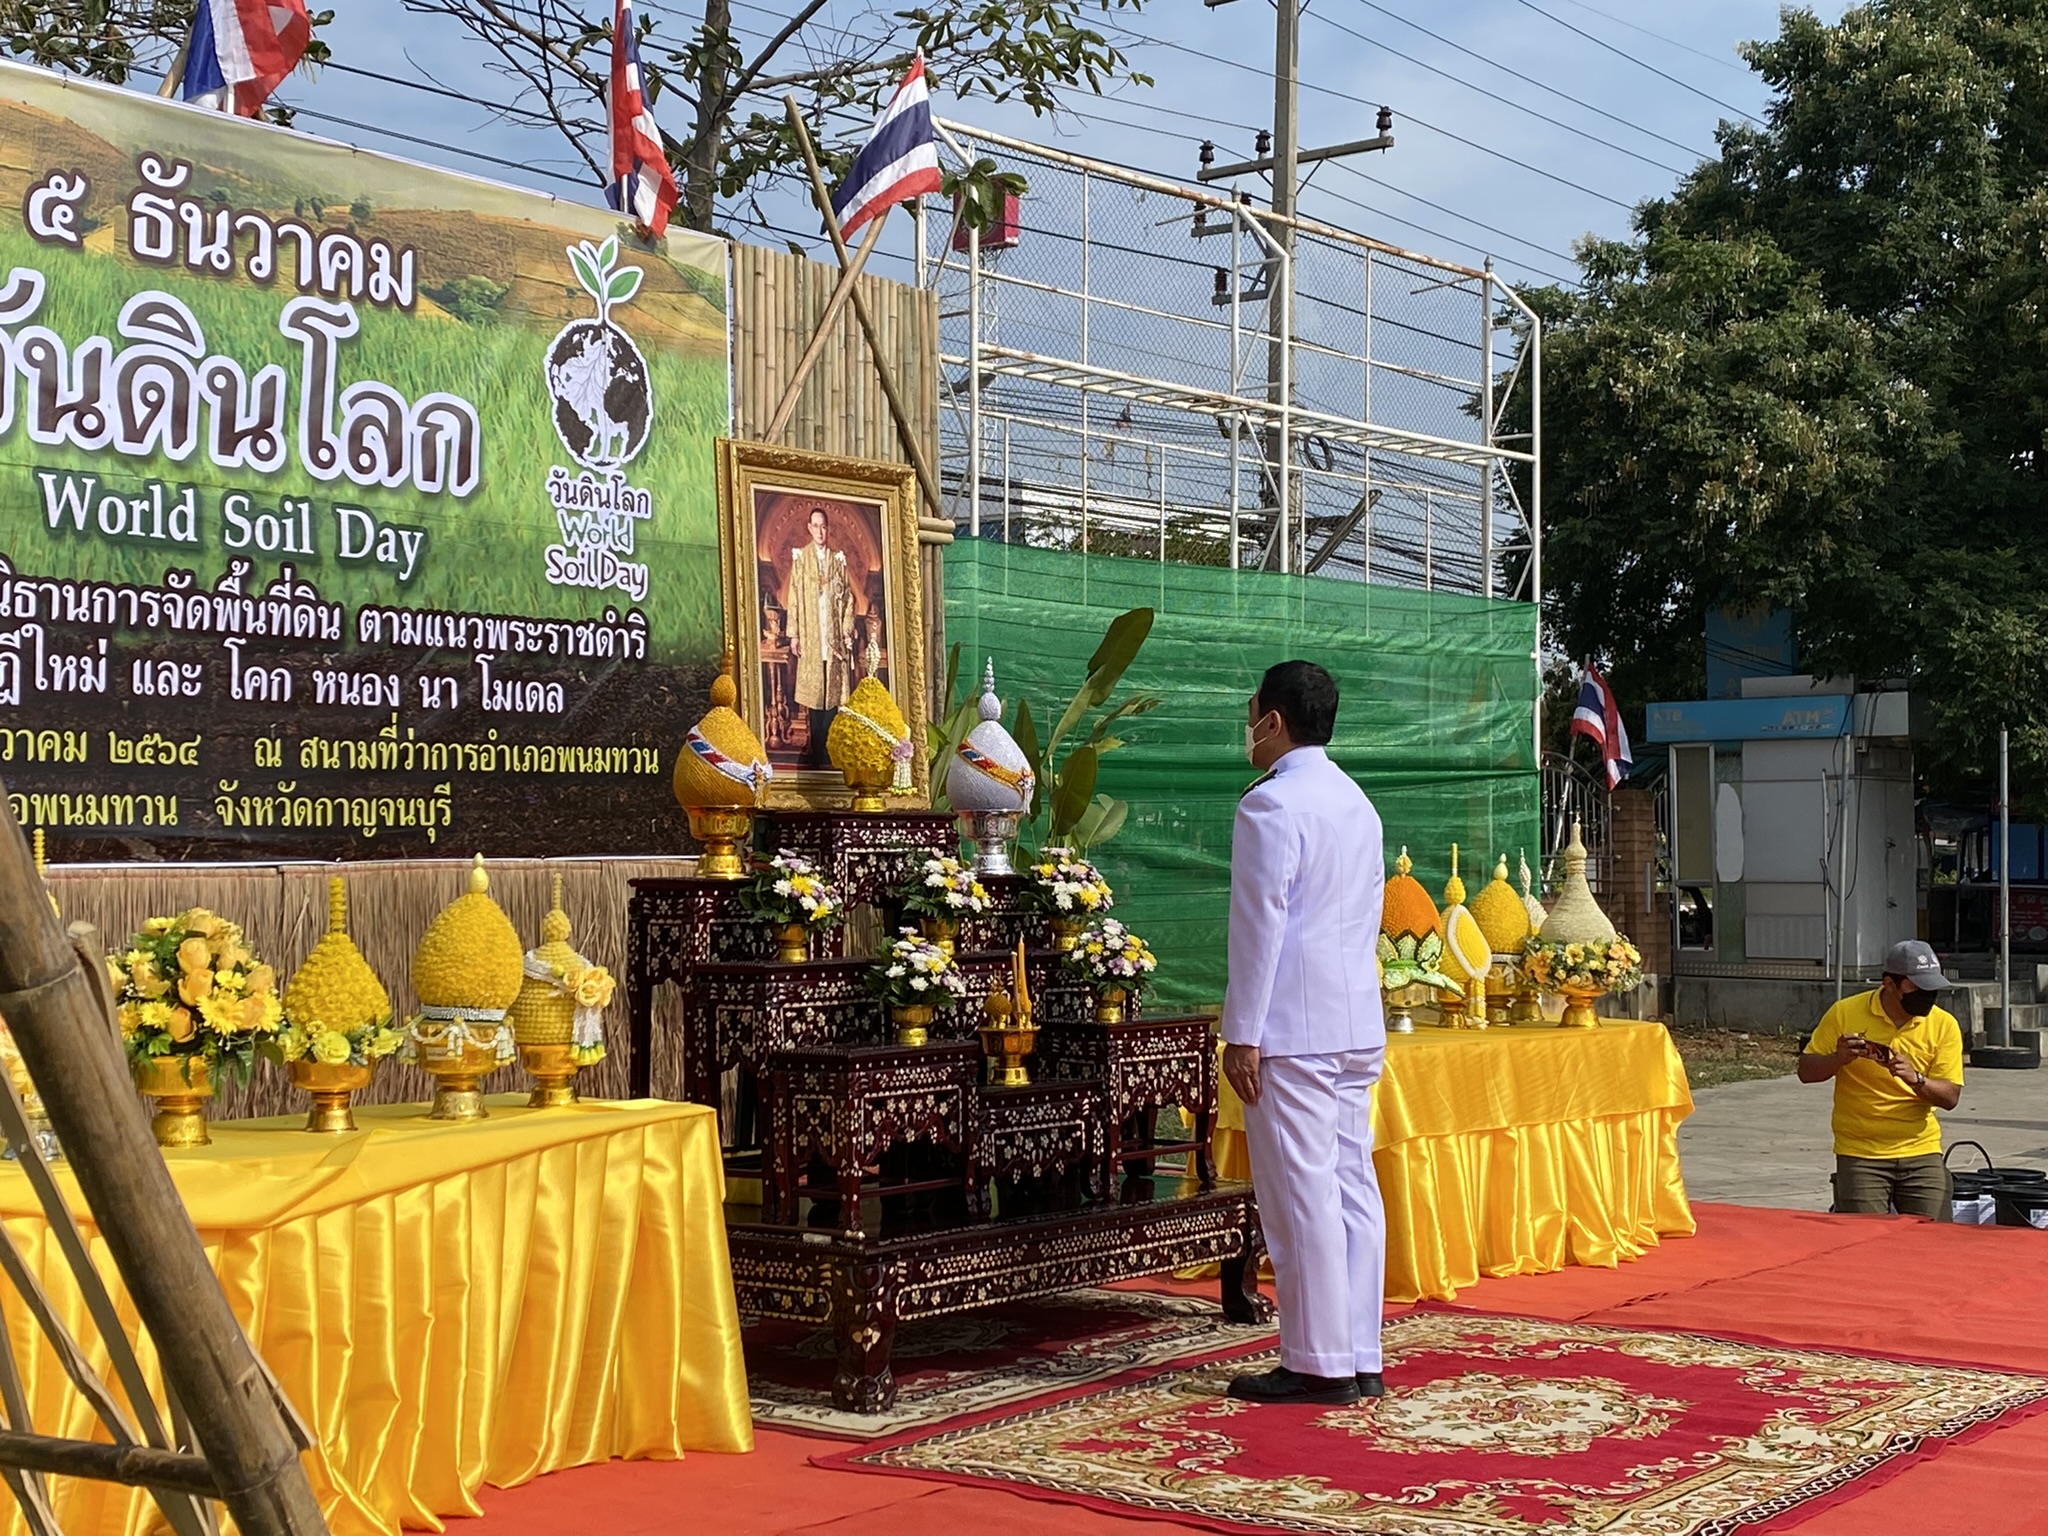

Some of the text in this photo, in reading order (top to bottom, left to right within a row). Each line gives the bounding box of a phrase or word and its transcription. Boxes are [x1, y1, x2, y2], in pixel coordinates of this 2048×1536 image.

[28, 155, 415, 308] ๕ ธันวาคม
[0, 272, 475, 492] นดินโลก
[549, 469, 649, 515] วันดินโลก
[38, 472, 425, 580] World Soil Day
[560, 511, 631, 549] World
[359, 609, 647, 660] ตามแนวพระราชดำริ
[132, 657, 202, 697] และ
[223, 637, 292, 702] โคก
[312, 668, 401, 708] หนอง
[419, 674, 458, 710] นา
[475, 653, 565, 715] โมเดล
[107, 730, 202, 766] ๒๕๖๔
[254, 736, 283, 768] ณ
[299, 711, 660, 775] สนามที่ว่าการอำเภอพนมทวน
[1781, 709, 1820, 726] ATM
[214, 778, 453, 844] จังหวัดกาญจนบุรี
